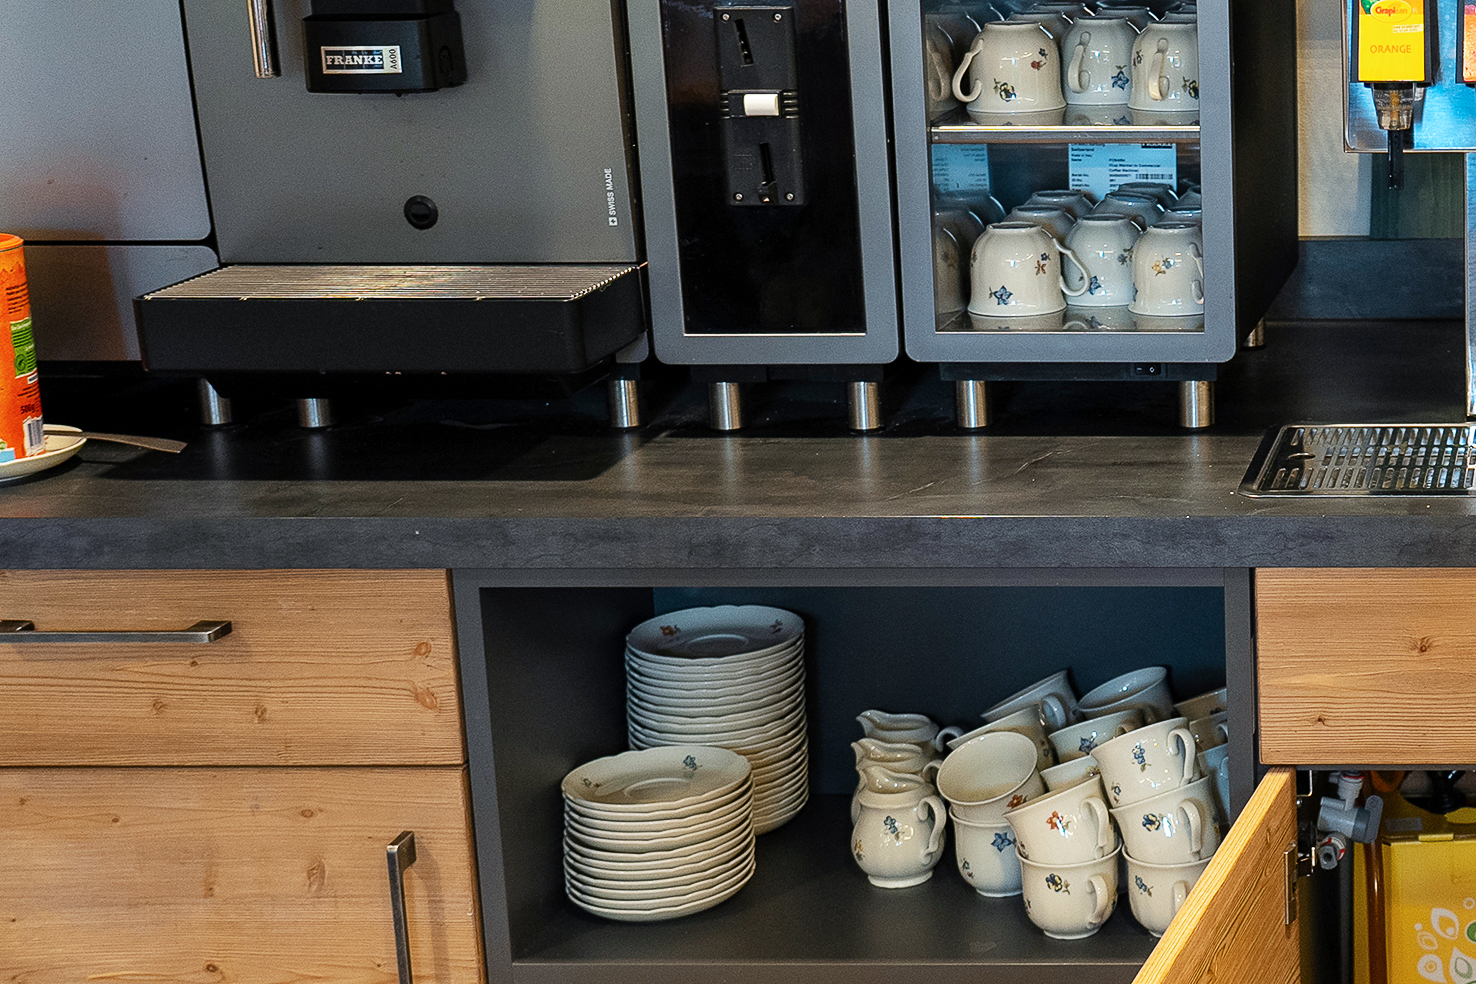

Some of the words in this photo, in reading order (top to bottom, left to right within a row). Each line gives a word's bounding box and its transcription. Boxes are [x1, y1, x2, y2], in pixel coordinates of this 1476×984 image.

[388, 48, 398, 70] A600
[1370, 44, 1412, 54] ORANGE
[325, 55, 384, 66] FRANKE
[603, 167, 614, 191] MADE
[606, 191, 617, 216] SWISS
